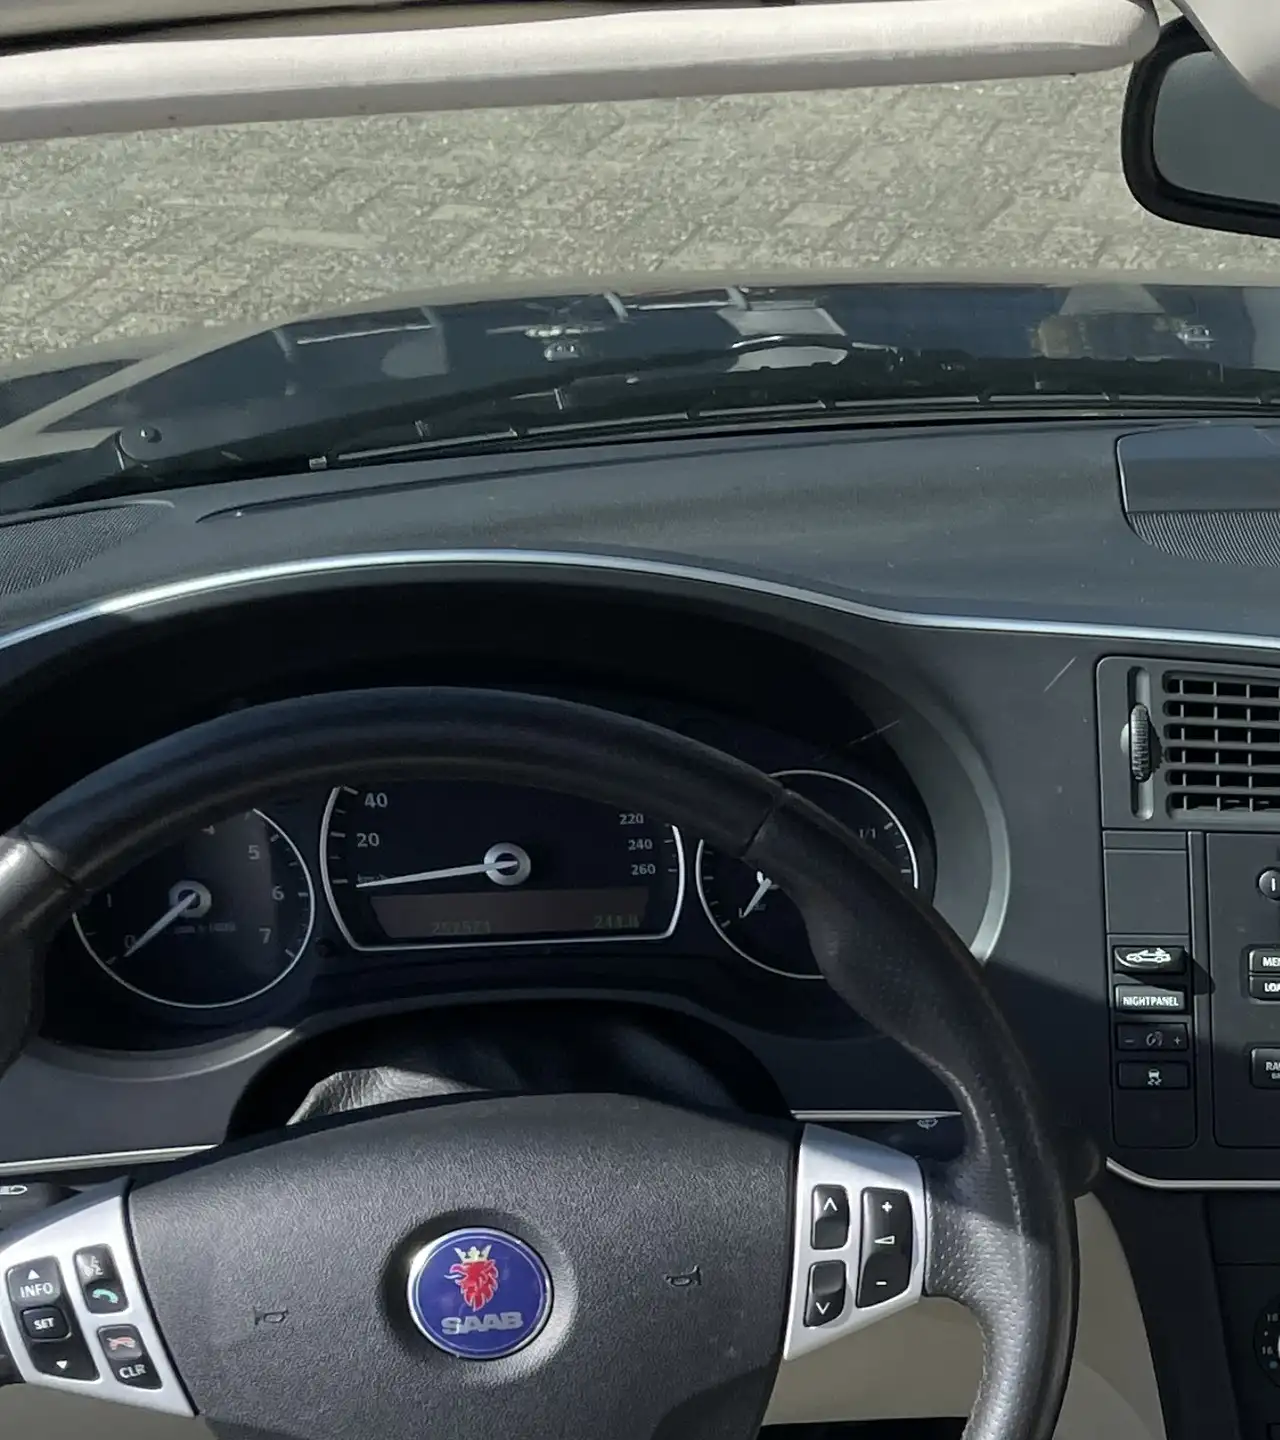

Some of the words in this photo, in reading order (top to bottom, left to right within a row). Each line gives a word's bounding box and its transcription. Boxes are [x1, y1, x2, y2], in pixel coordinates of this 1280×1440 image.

[364, 792, 389, 809] 40
[619, 813, 645, 826] 220
[356, 831, 381, 848] 20
[627, 838, 653, 851] 240
[248, 844, 261, 861] 5
[630, 863, 657, 876] 260
[271, 884, 285, 901] 6
[258, 927, 272, 944] 7
[1122, 995, 1180, 1007] NIGHTPANEL
[19, 1282, 54, 1298] INFO
[33, 1316, 55, 1330] SET
[441, 1311, 524, 1335] SAAB
[118, 1363, 147, 1379] CLR
